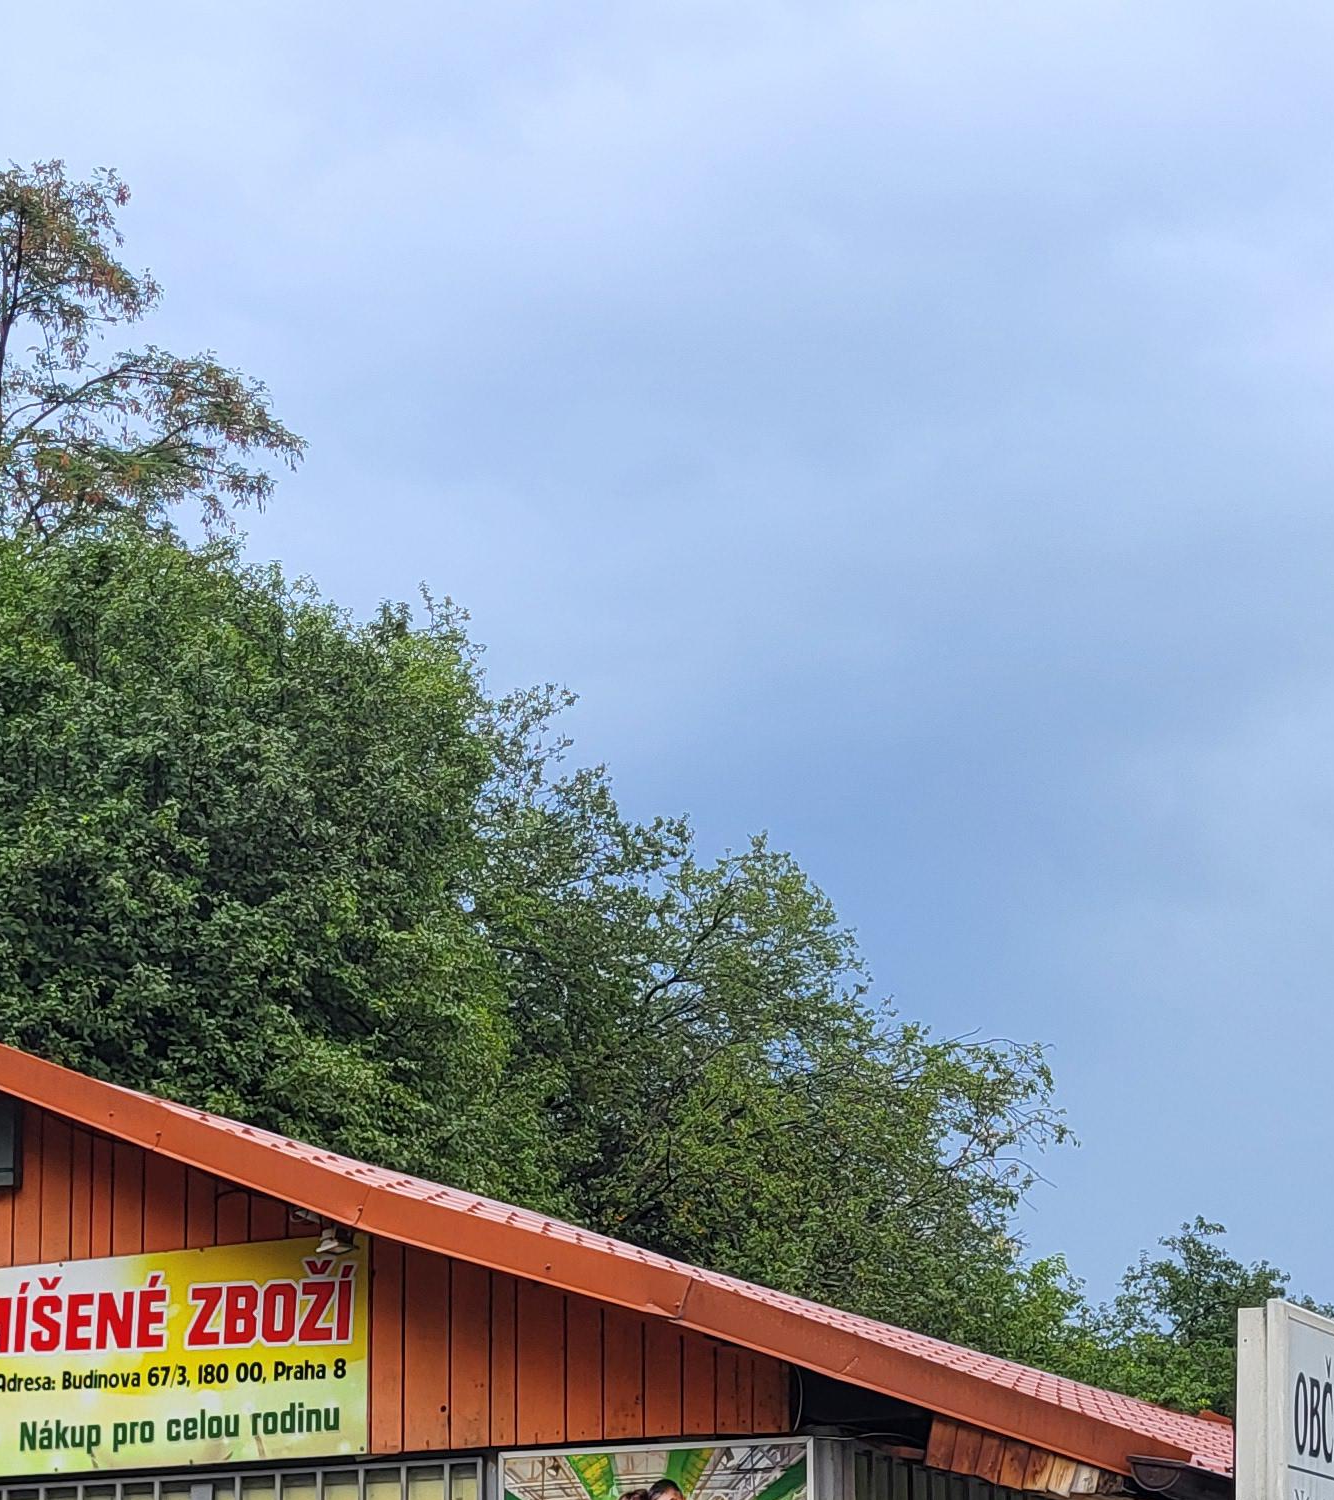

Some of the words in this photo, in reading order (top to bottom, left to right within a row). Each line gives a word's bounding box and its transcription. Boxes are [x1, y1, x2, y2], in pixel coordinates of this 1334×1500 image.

[188, 1260, 355, 1347] ZBOŽÍ
[147, 1363, 191, 1388] 67/3,
[198, 1363, 229, 1385] 180
[236, 1362, 267, 1385] 00,
[274, 1360, 326, 1381] Praha
[333, 1358, 347, 1379] 8
[20, 1420, 101, 1454] Nákup
[113, 1420, 154, 1452] pro
[167, 1409, 240, 1441] celou
[252, 1403, 341, 1435] rodinu
